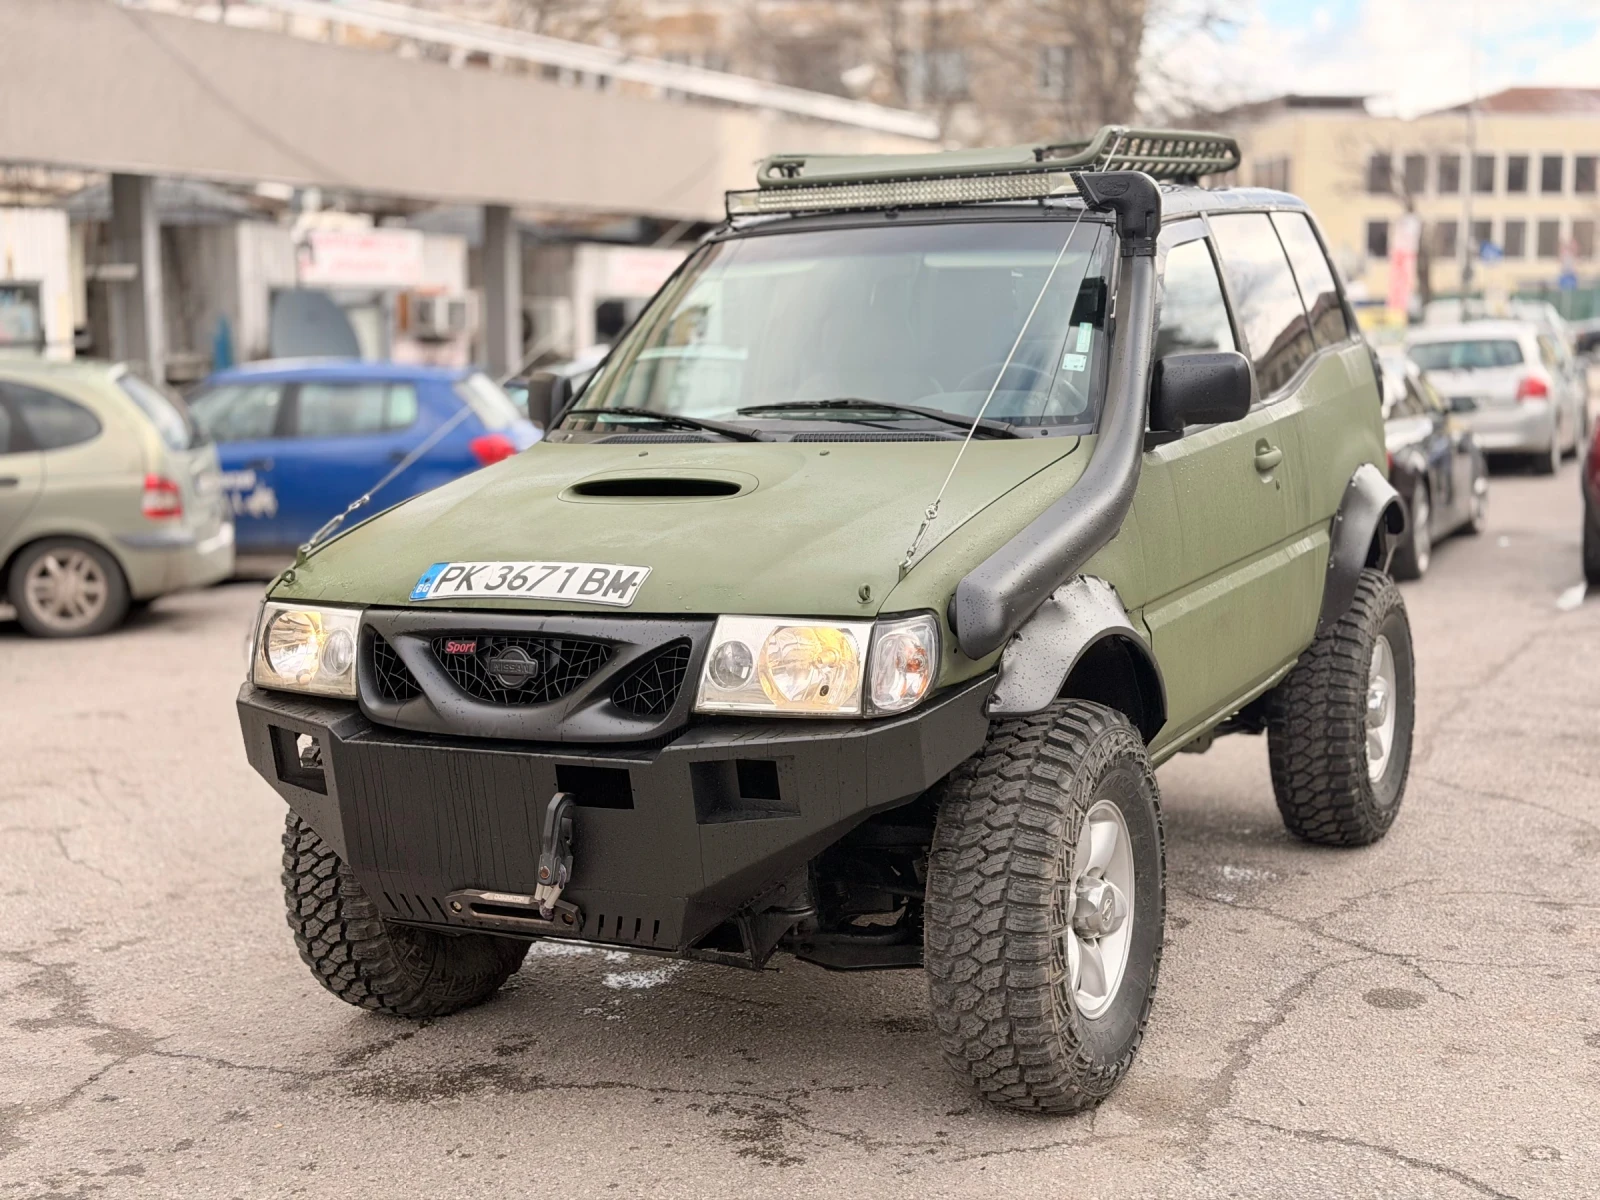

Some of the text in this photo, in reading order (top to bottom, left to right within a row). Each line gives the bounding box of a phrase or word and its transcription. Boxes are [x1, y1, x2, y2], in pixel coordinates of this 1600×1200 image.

[415, 583, 431, 593] BG
[433, 565, 640, 599] PK 3671 BM
[446, 641, 475, 654] Sport
[493, 663, 531, 674] NISSAN
